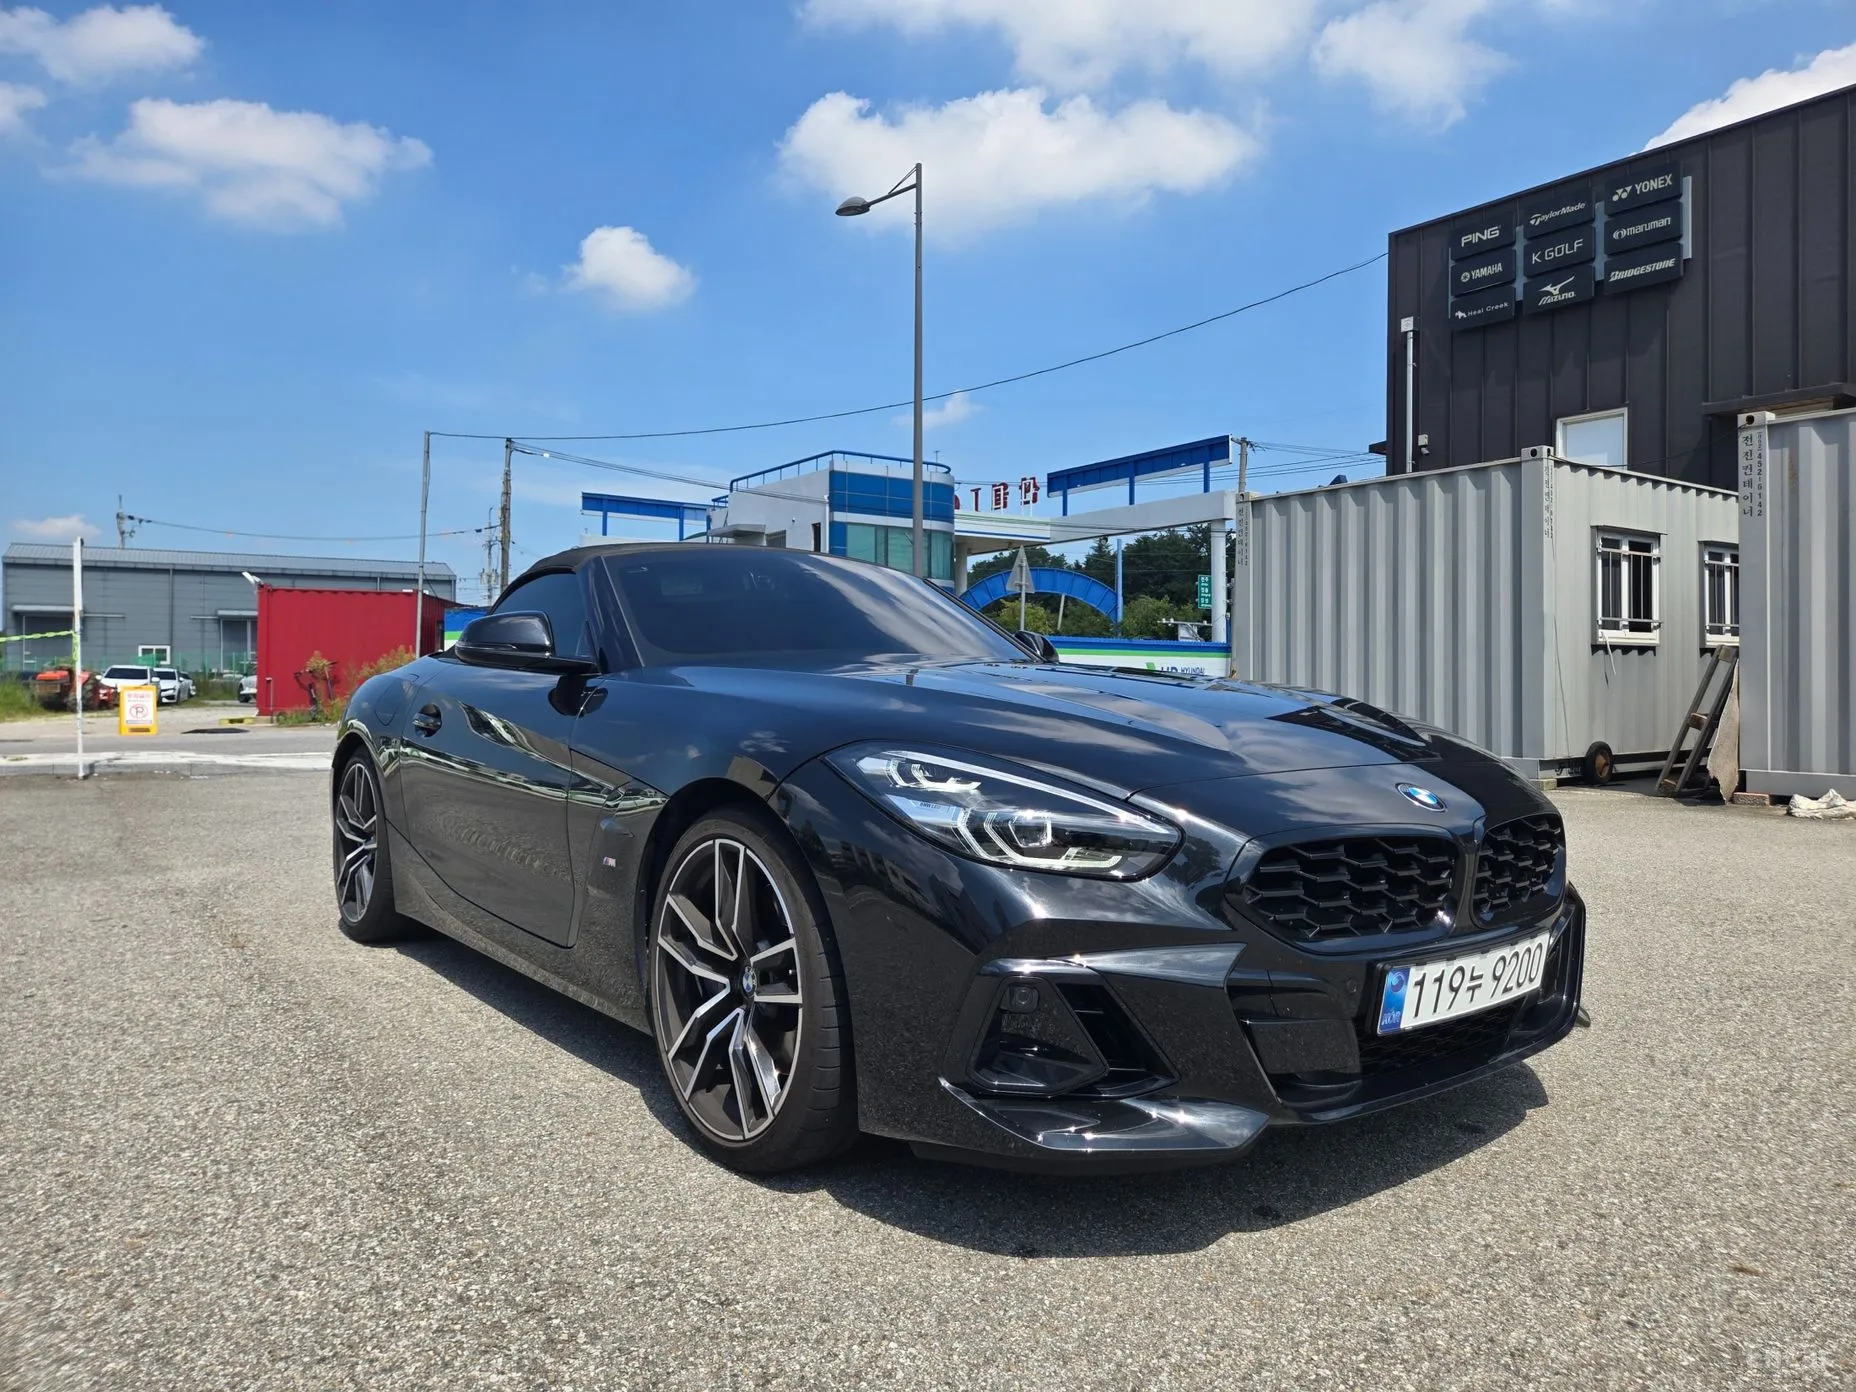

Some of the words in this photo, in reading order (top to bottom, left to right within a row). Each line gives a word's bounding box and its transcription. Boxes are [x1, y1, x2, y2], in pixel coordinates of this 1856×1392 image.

[1634, 173, 1673, 195] YONEX
[1530, 202, 1585, 226] TaylorMade
[1461, 226, 1500, 247] PING
[1626, 217, 1671, 236] maruman
[1532, 250, 1542, 265] K
[1544, 238, 1584, 261] GOLF
[1471, 262, 1503, 280] YAMAHA
[1608, 258, 1677, 282] BRIDGESTONE
[1486, 301, 1509, 312] Creek
[1414, 965, 1484, 1019] 119누
[1490, 942, 1543, 999] 9200
